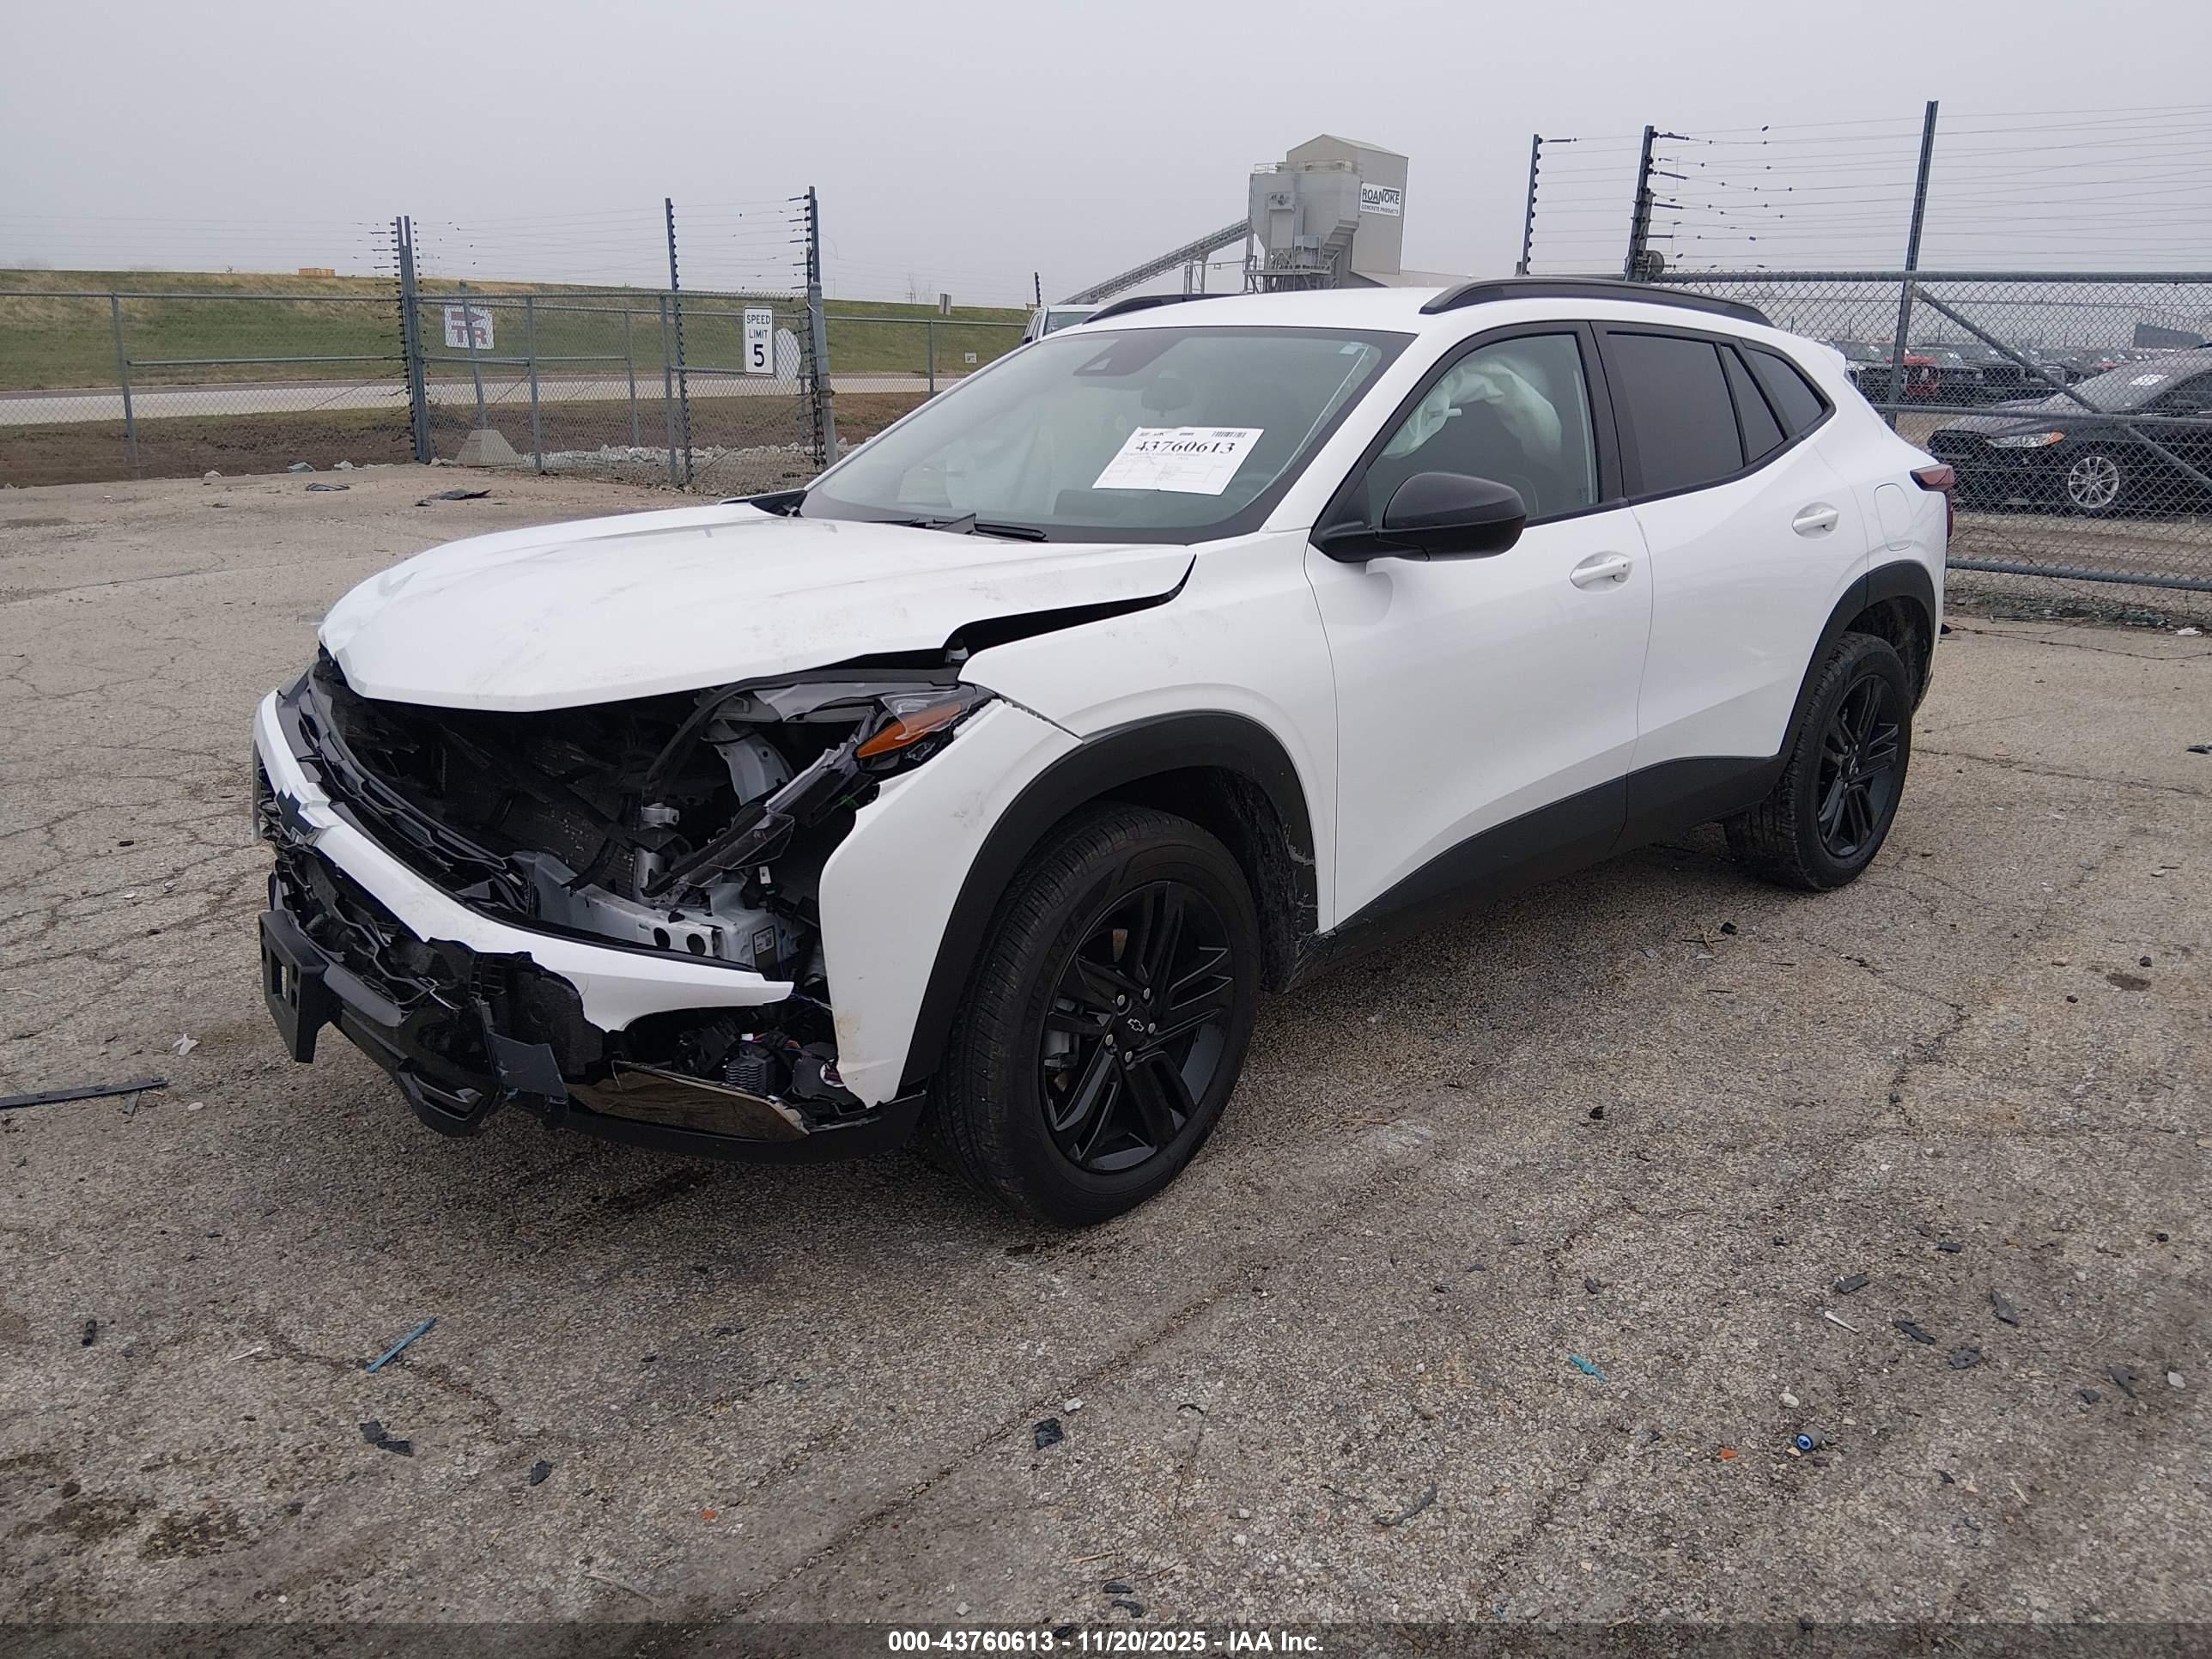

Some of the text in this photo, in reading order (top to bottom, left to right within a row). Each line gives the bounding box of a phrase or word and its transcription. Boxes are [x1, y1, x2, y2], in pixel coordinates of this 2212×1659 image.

[1362, 188, 1400, 204] ROANOKE
[746, 314, 771, 325] SPEED
[749, 329, 768, 339] LIMIT
[753, 343, 765, 368] 5
[1135, 441, 1236, 454] 43760613
